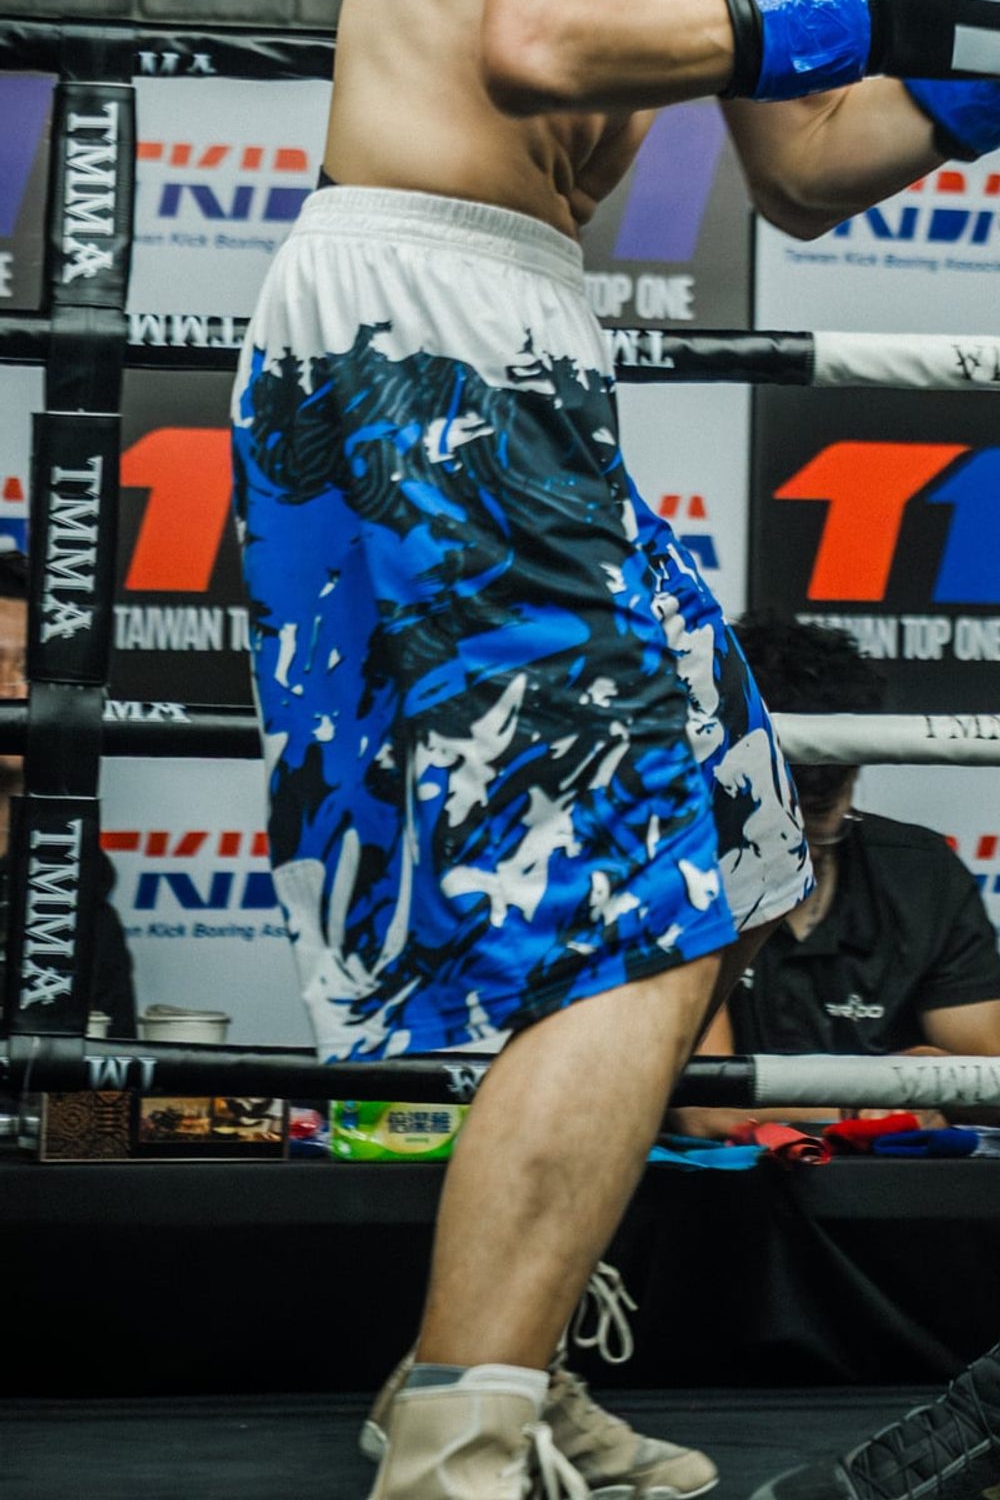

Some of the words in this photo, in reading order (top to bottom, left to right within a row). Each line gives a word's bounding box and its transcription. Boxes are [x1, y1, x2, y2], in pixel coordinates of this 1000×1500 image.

[62, 102, 118, 283] TMMA
[635, 273, 696, 321] ONE
[127, 314, 247, 349] TMM
[40, 454, 104, 644] TMMA
[113, 605, 223, 651] TAIWAN
[900, 614, 951, 660] TOP
[19, 818, 83, 1011] TMMA
